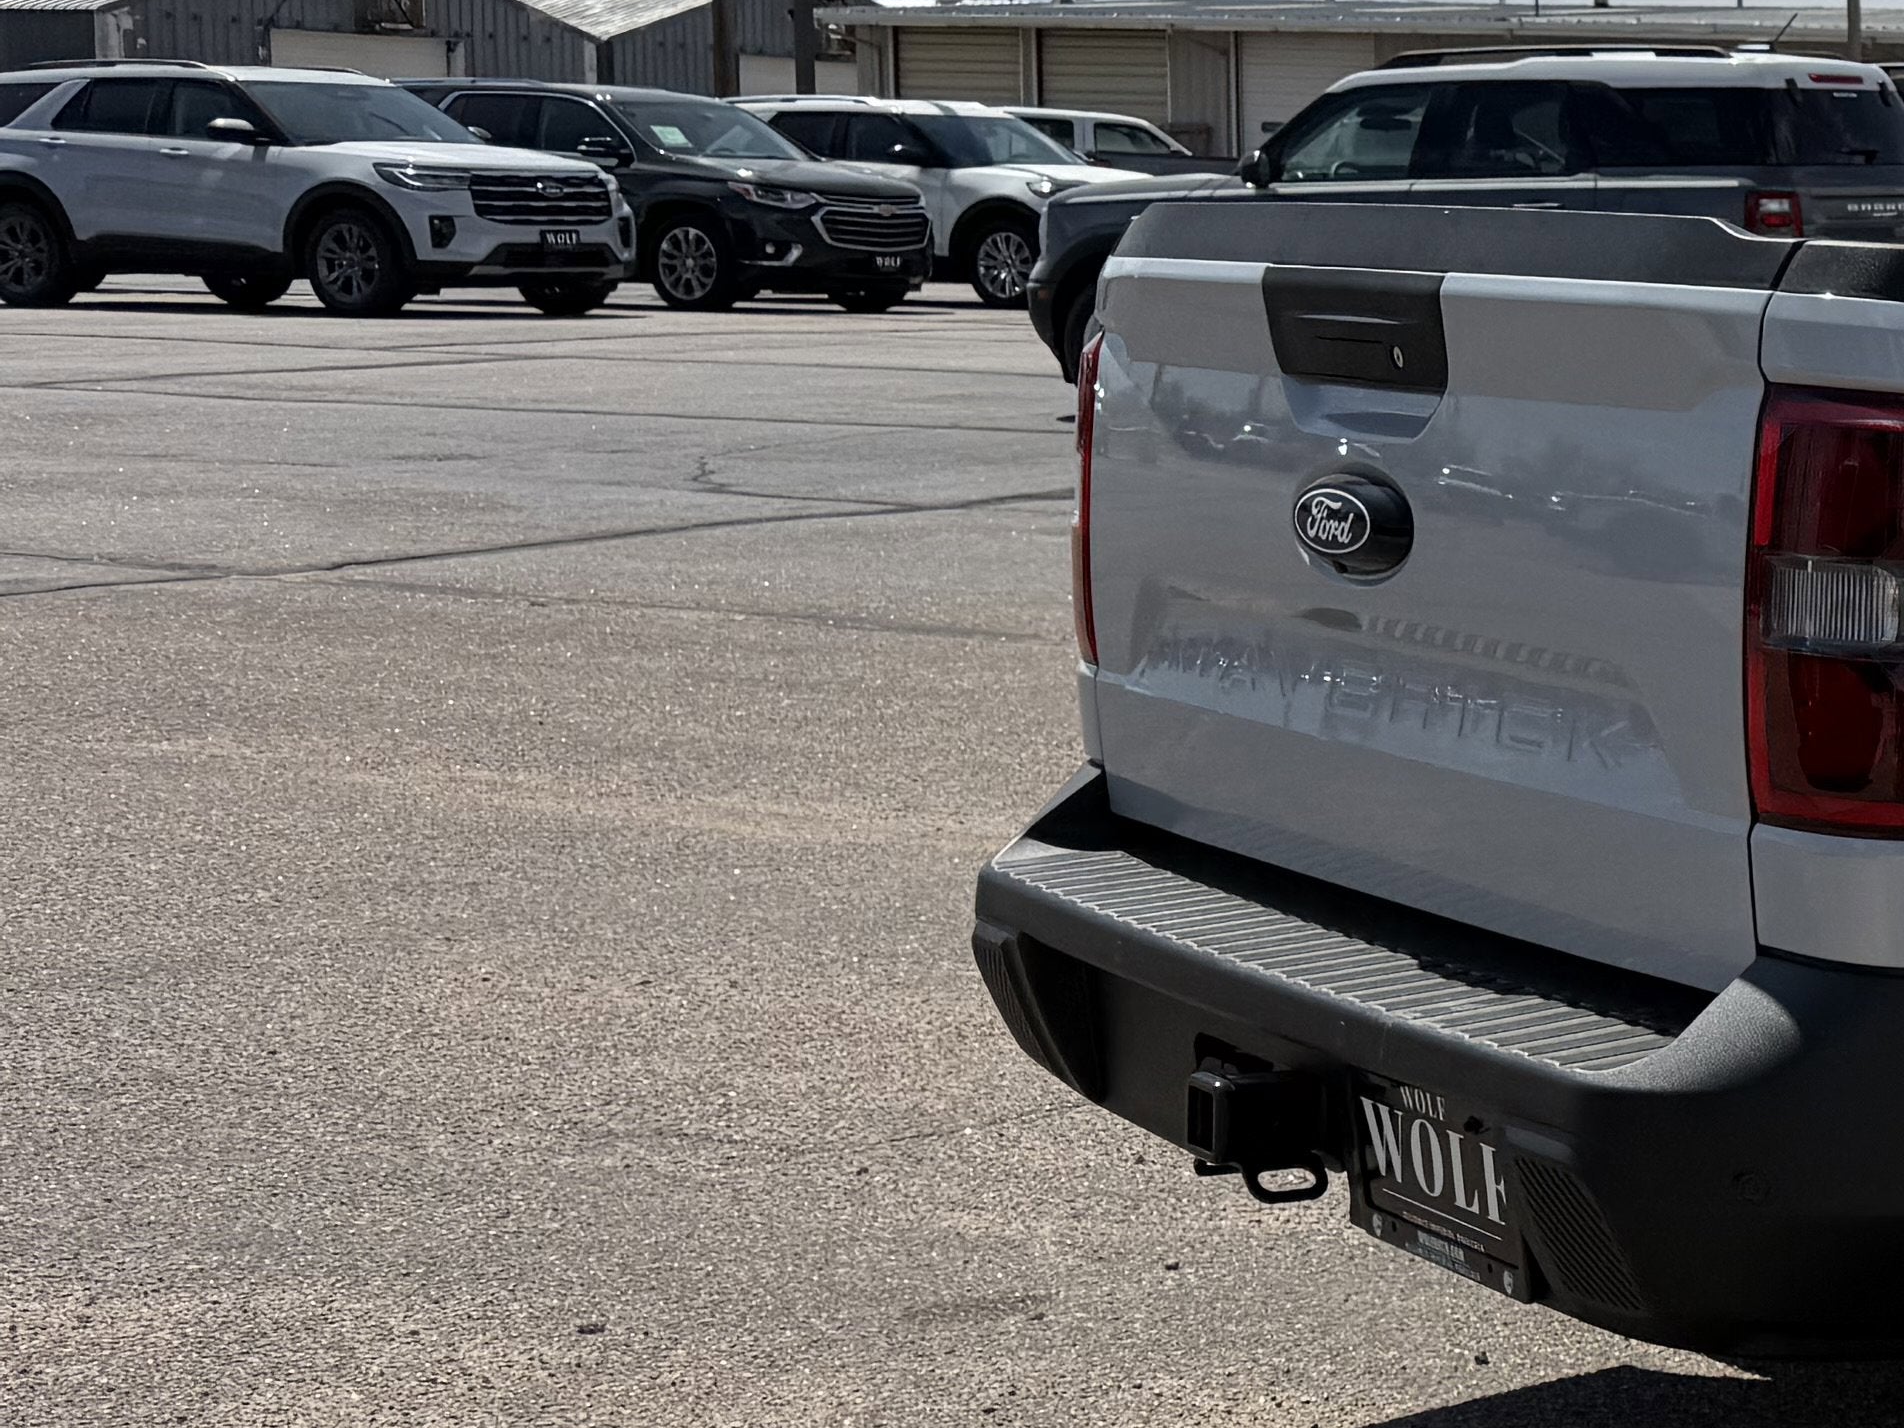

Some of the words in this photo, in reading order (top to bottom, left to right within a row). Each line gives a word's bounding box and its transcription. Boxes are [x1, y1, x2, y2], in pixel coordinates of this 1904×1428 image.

[1306, 495, 1355, 544] Ford
[1400, 1085, 1446, 1121] WOLF
[1360, 1096, 1507, 1226] WOLF
